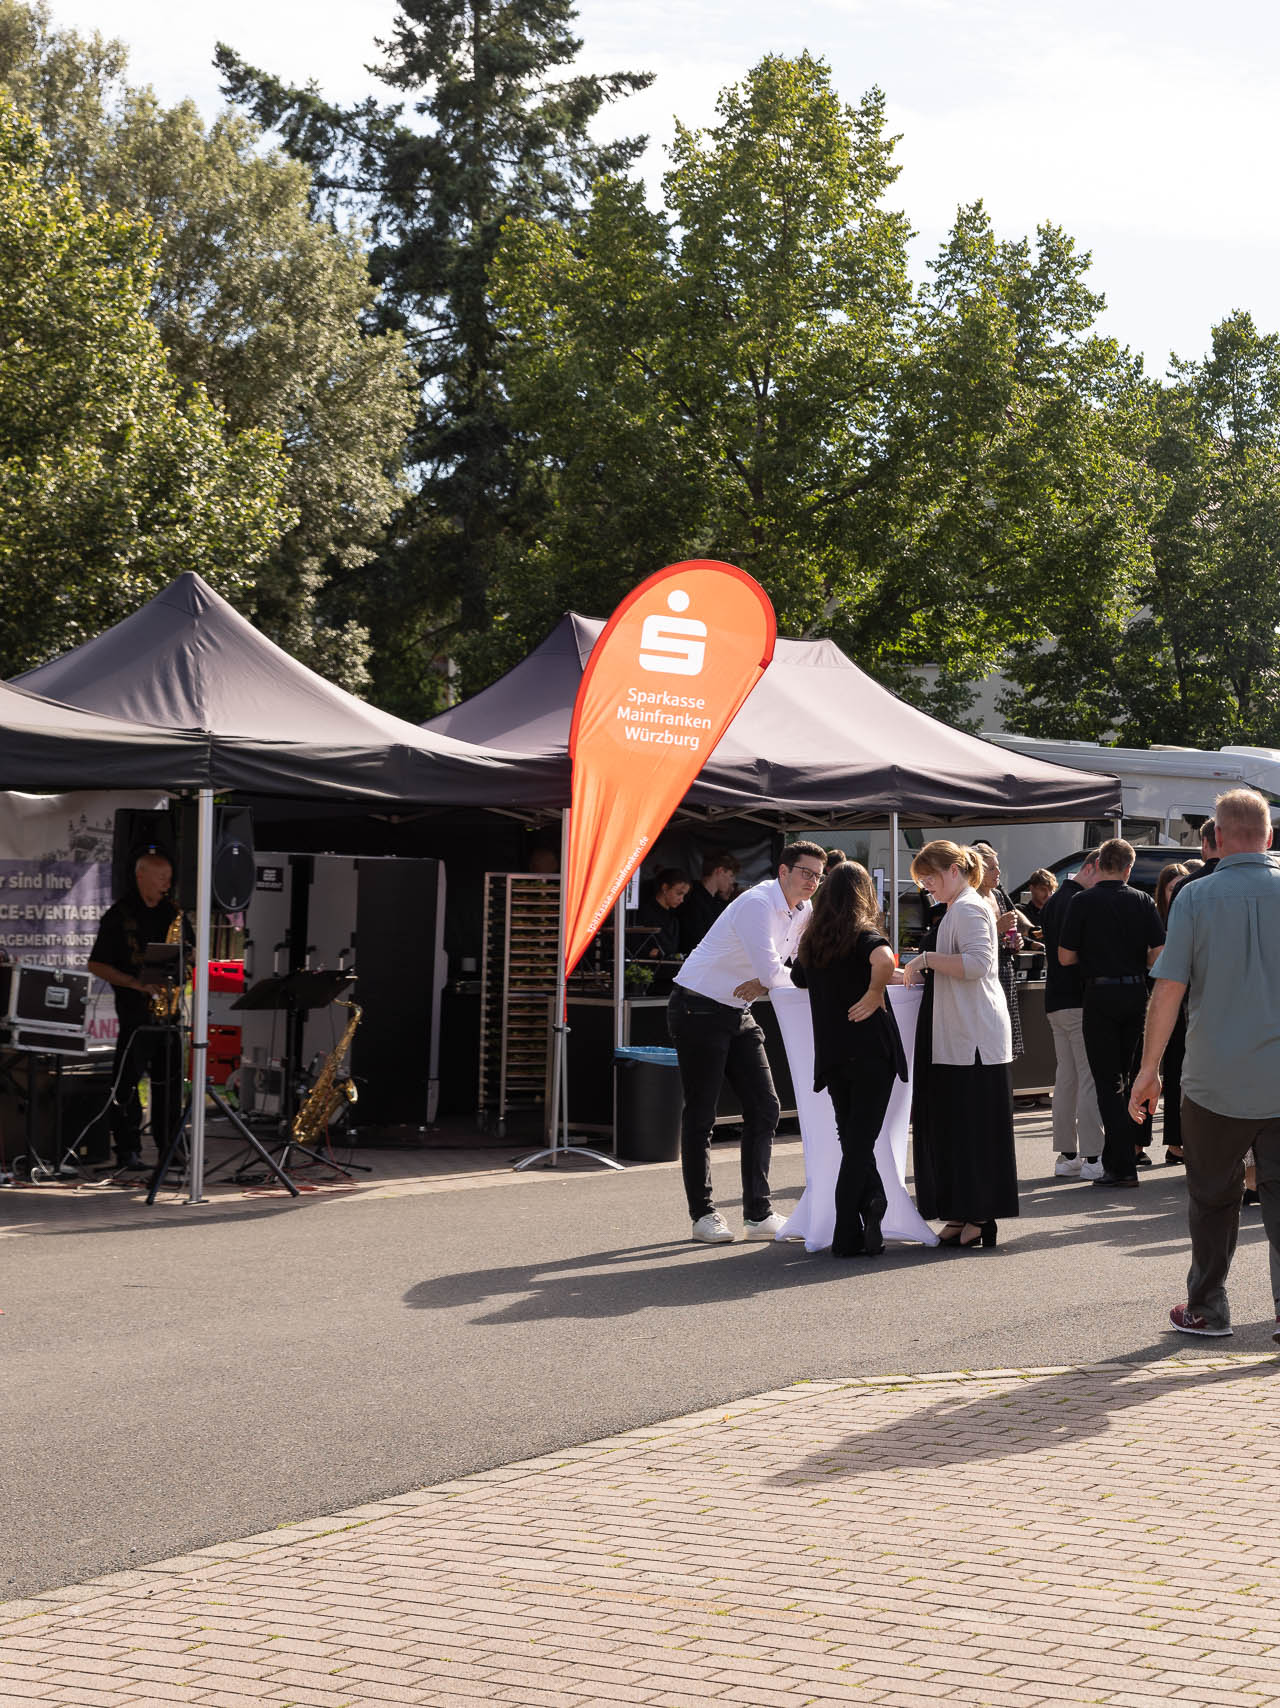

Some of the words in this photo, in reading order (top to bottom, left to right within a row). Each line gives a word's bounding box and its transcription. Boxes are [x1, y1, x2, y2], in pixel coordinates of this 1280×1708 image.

[627, 687, 705, 710] Sparkasse
[616, 705, 712, 729] Mainfranken
[624, 726, 700, 751] Würzburg
[8, 872, 43, 889] sind
[46, 873, 73, 889] Ihre
[586, 835, 649, 933] sparkasse-mainfranken.de
